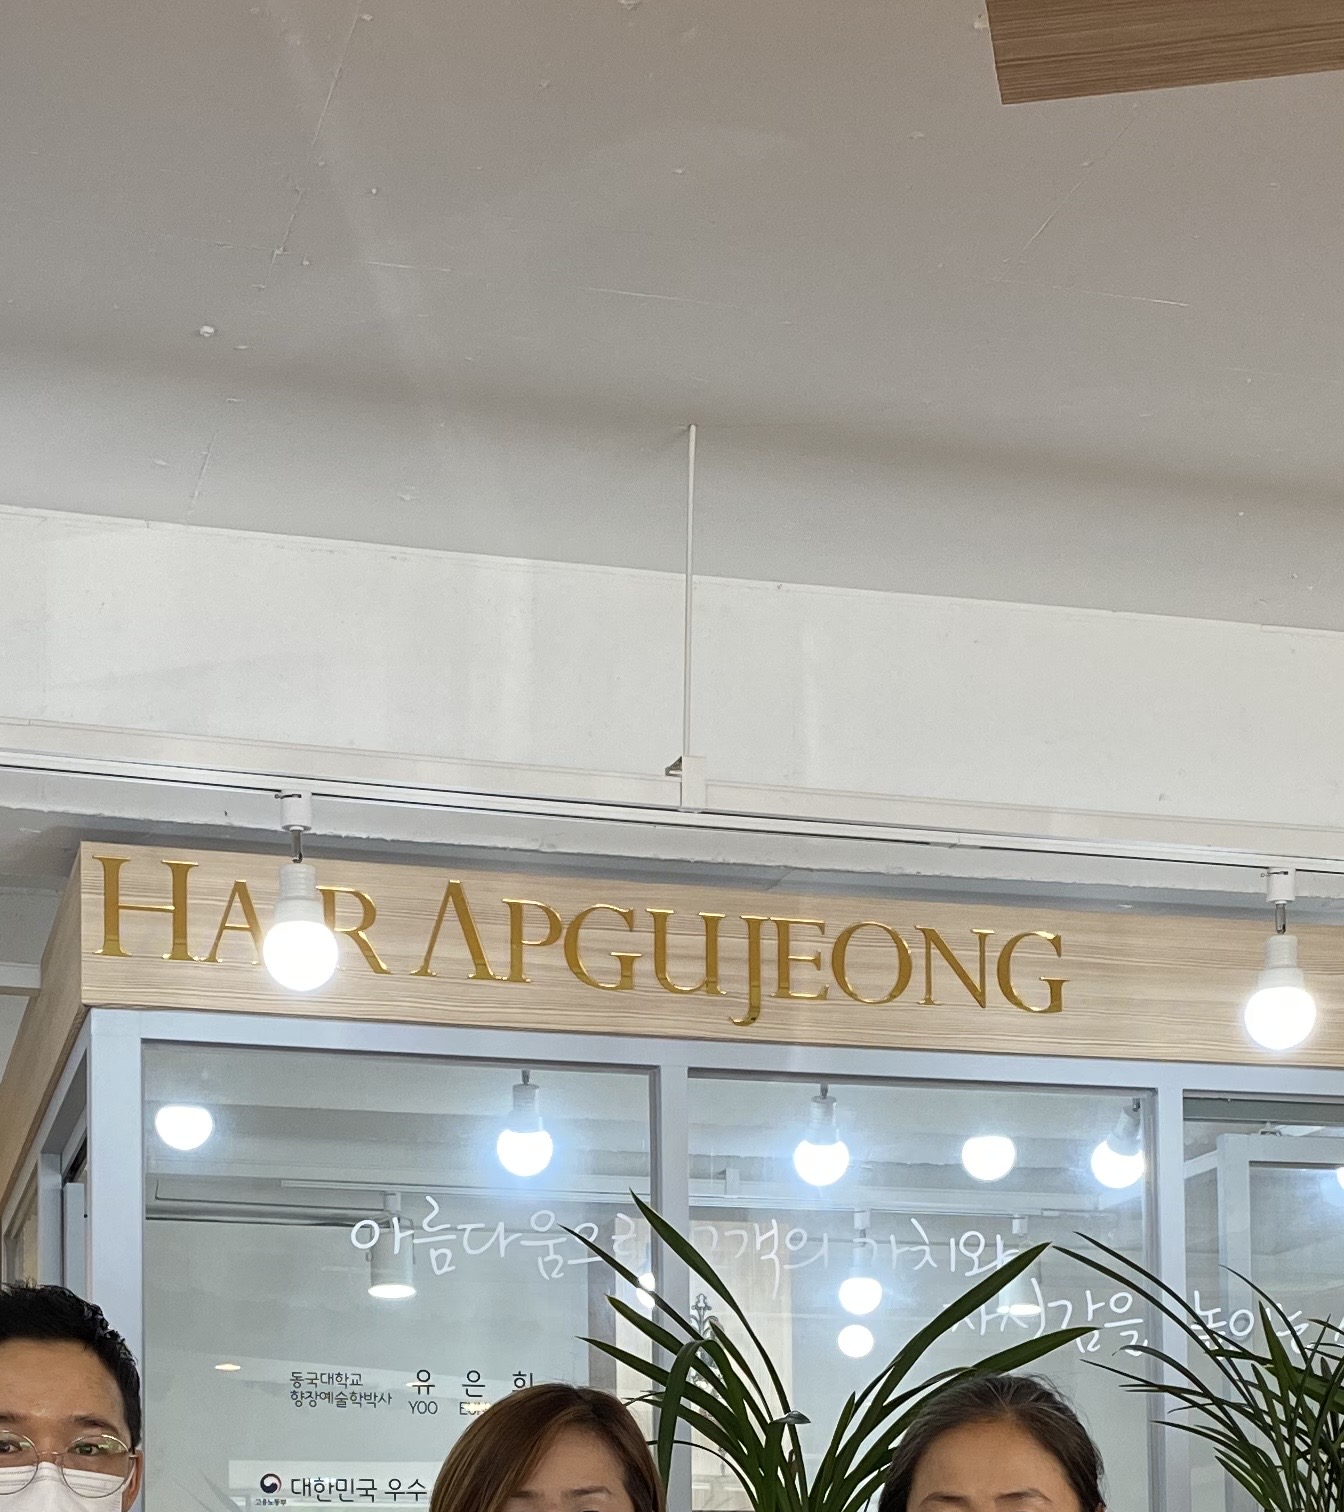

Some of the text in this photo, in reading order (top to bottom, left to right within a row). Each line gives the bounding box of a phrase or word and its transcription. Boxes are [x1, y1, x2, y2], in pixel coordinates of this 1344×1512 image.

[92, 855, 1071, 1027] HAR APGUJEONG
[289, 1371, 363, 1388] 동국대학교
[289, 1389, 392, 1408] 향장예술학박사
[408, 1400, 439, 1415] YOO
[290, 1476, 378, 1503] 대한민국
